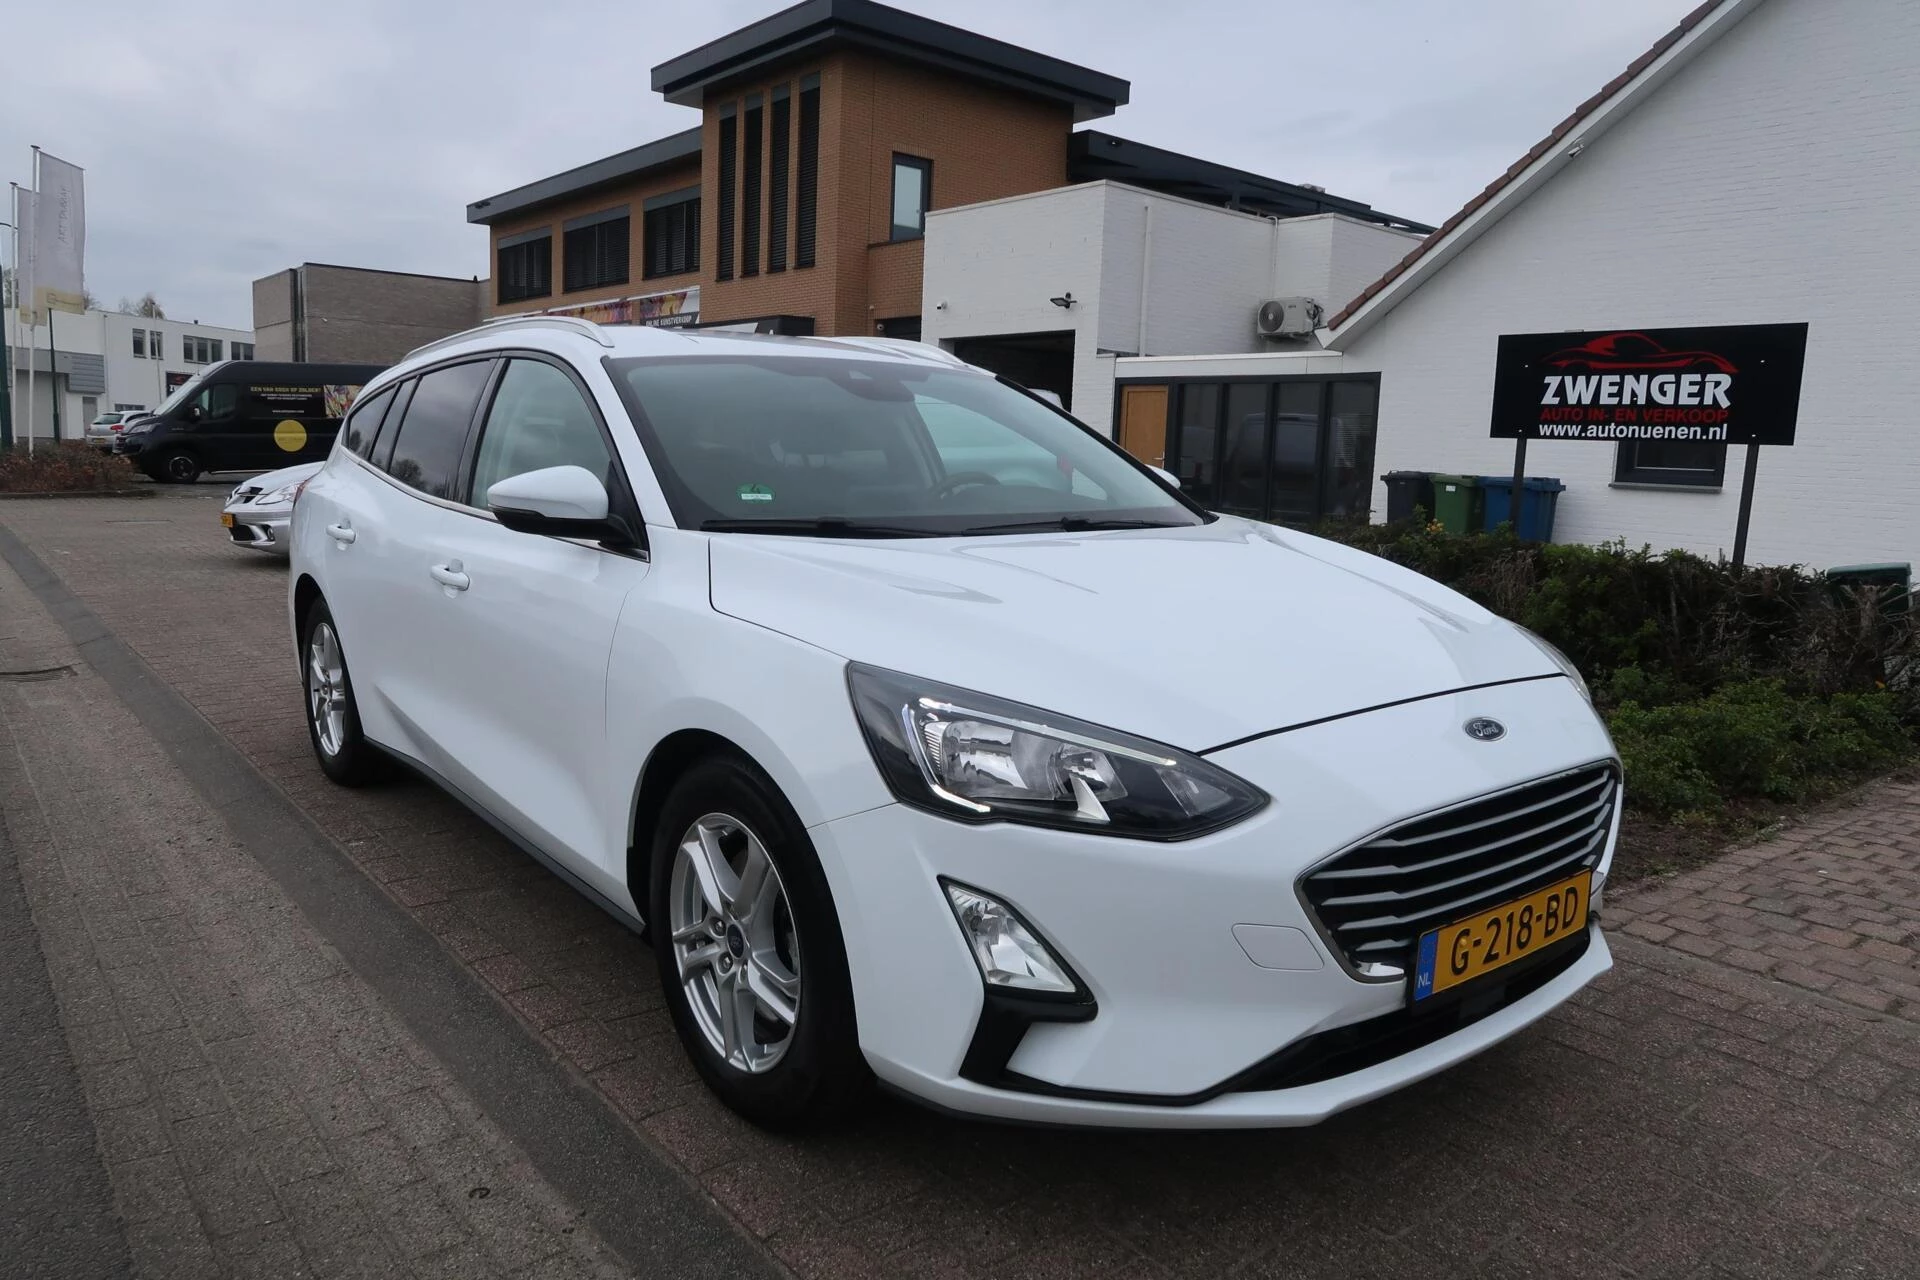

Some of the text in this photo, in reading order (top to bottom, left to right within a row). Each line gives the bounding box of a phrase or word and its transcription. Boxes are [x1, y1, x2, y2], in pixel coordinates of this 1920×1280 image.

[1540, 373, 1731, 409] ZWENGER
[1540, 408, 1729, 423] AUTO IN- EN VERKOOP
[1539, 422, 1728, 440] www.autonuenen.nl
[1472, 721, 1499, 737] Ford
[1451, 886, 1578, 976] G-218-BD
[1418, 971, 1431, 987] NL
